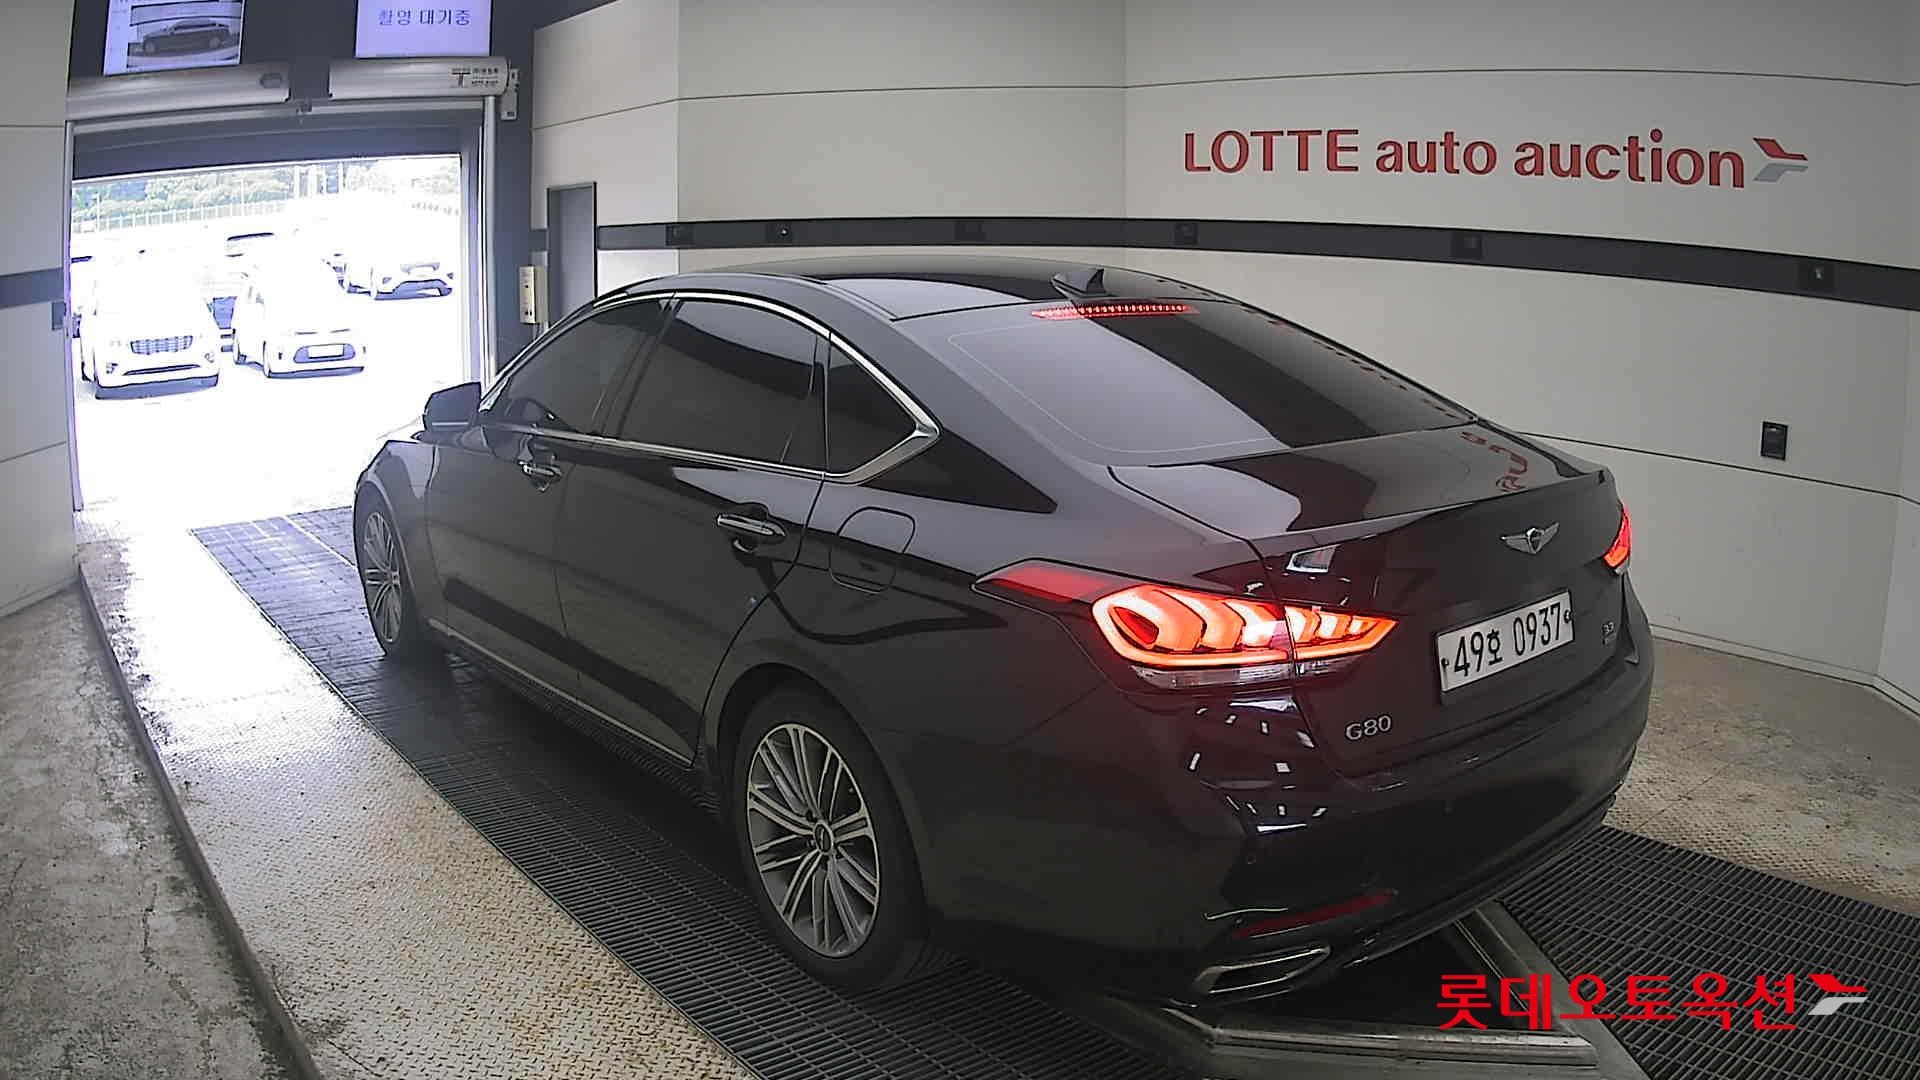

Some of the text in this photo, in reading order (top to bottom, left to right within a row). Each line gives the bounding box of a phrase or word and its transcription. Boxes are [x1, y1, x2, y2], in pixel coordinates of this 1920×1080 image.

[419, 9, 470, 26] 대기중
[1185, 129, 1745, 188] LOTTE auto auction
[1453, 629, 1503, 677] 49호
[1513, 601, 1561, 656] 0937
[1346, 715, 1391, 740] G80
